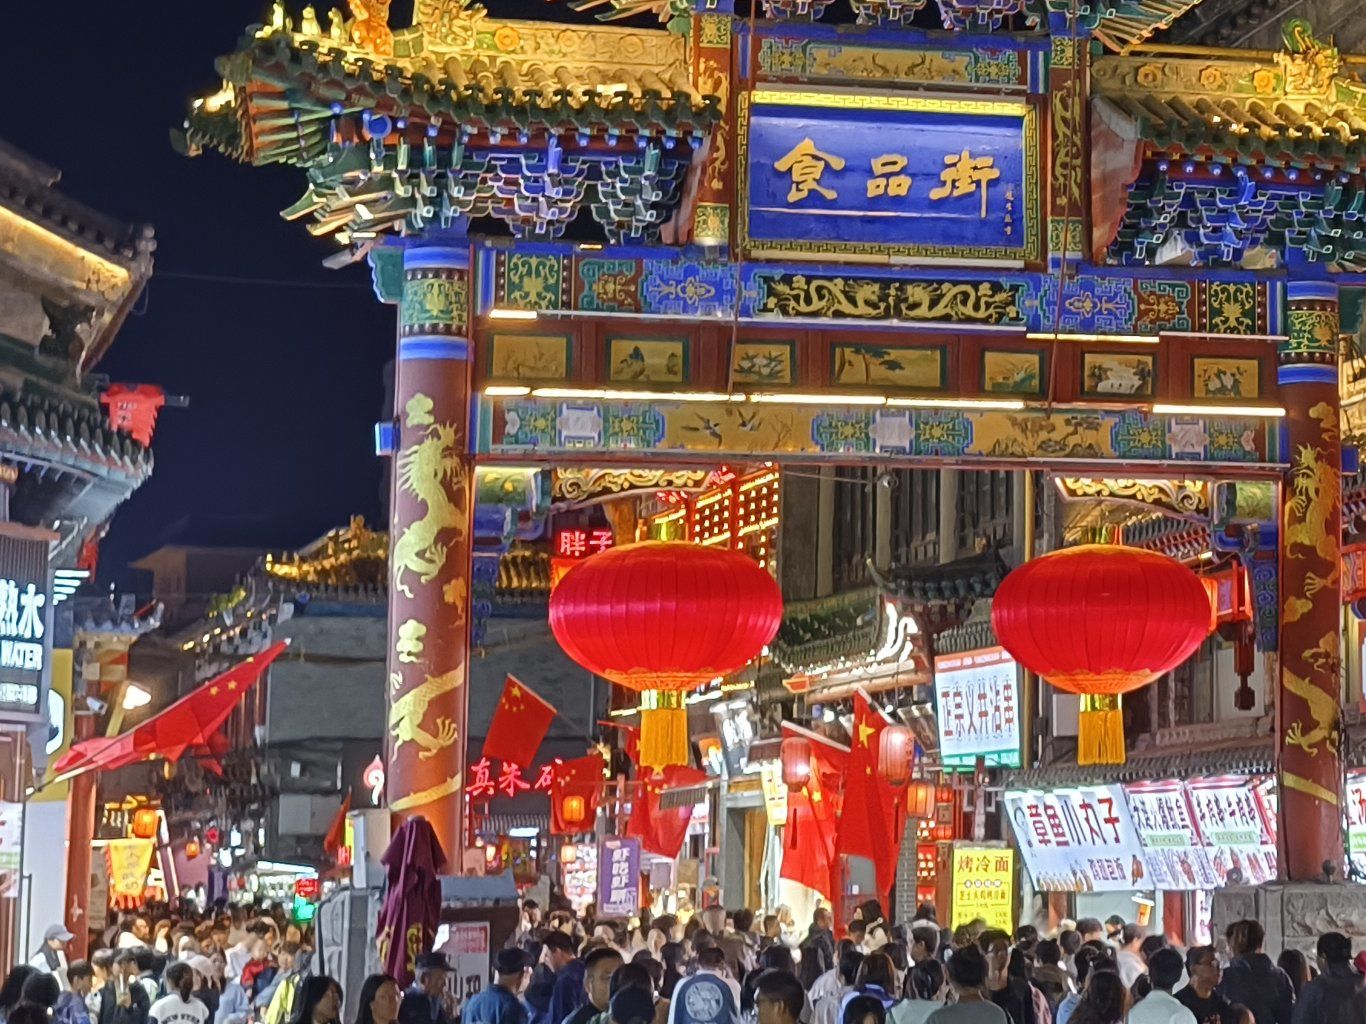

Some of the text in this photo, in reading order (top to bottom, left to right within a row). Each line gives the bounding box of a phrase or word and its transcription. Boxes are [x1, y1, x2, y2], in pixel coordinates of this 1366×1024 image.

[773, 137, 1000, 218] 食品街
[1027, 797, 1121, 847] 章鱼小丸子
[958, 855, 1009, 873] 烤冷面
